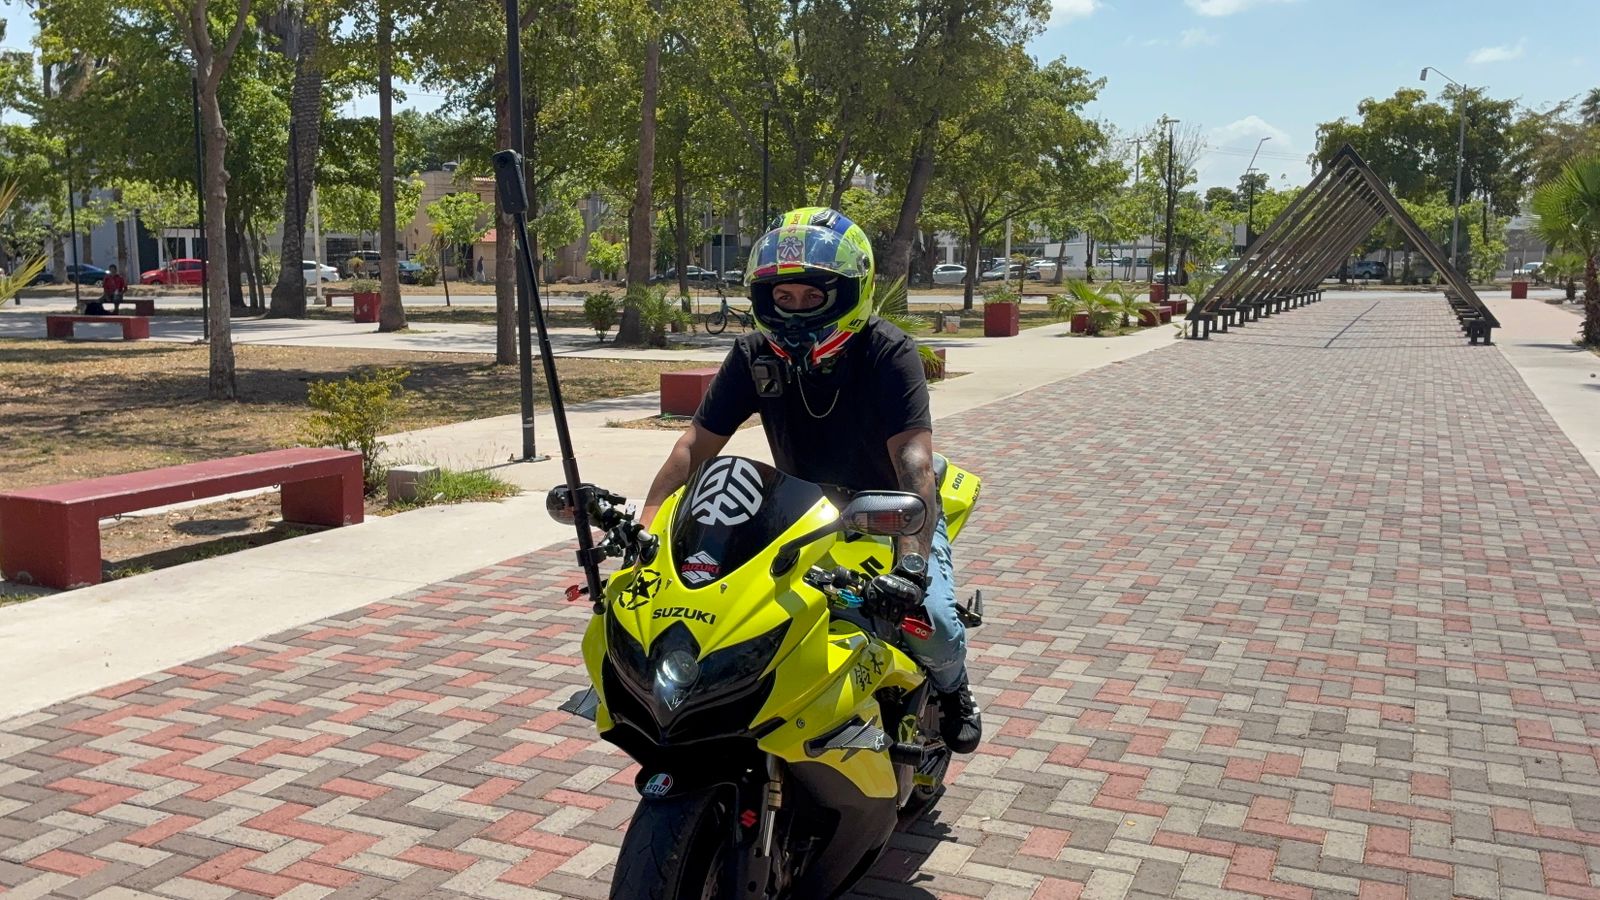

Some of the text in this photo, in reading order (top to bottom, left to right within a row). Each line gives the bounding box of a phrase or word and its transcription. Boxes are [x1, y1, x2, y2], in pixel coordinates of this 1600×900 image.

[952, 472, 965, 490] 600
[681, 563, 720, 573] SUZUKI
[652, 607, 716, 625] SUZUKI
